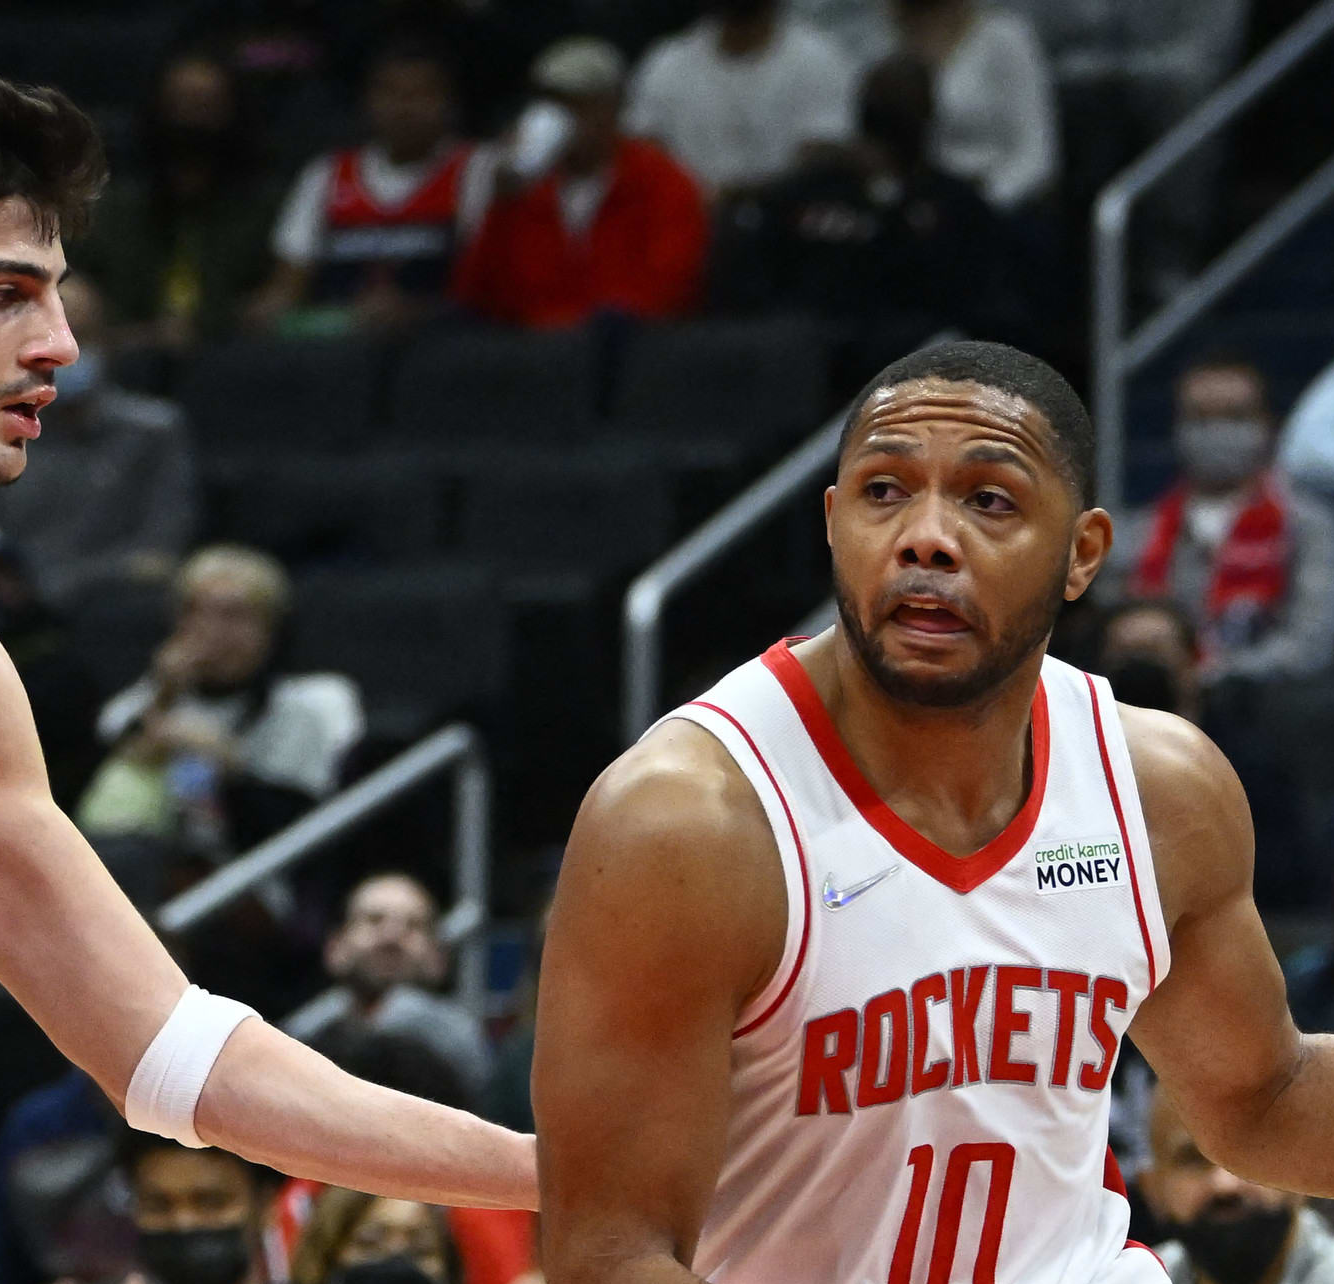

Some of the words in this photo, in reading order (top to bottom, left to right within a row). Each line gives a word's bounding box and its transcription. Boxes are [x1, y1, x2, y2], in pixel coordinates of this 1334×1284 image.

[1035, 843, 1075, 864] credit
[1077, 842, 1120, 859] karma
[1036, 857, 1121, 890] MONEY
[795, 963, 1129, 1118] ROCKETS
